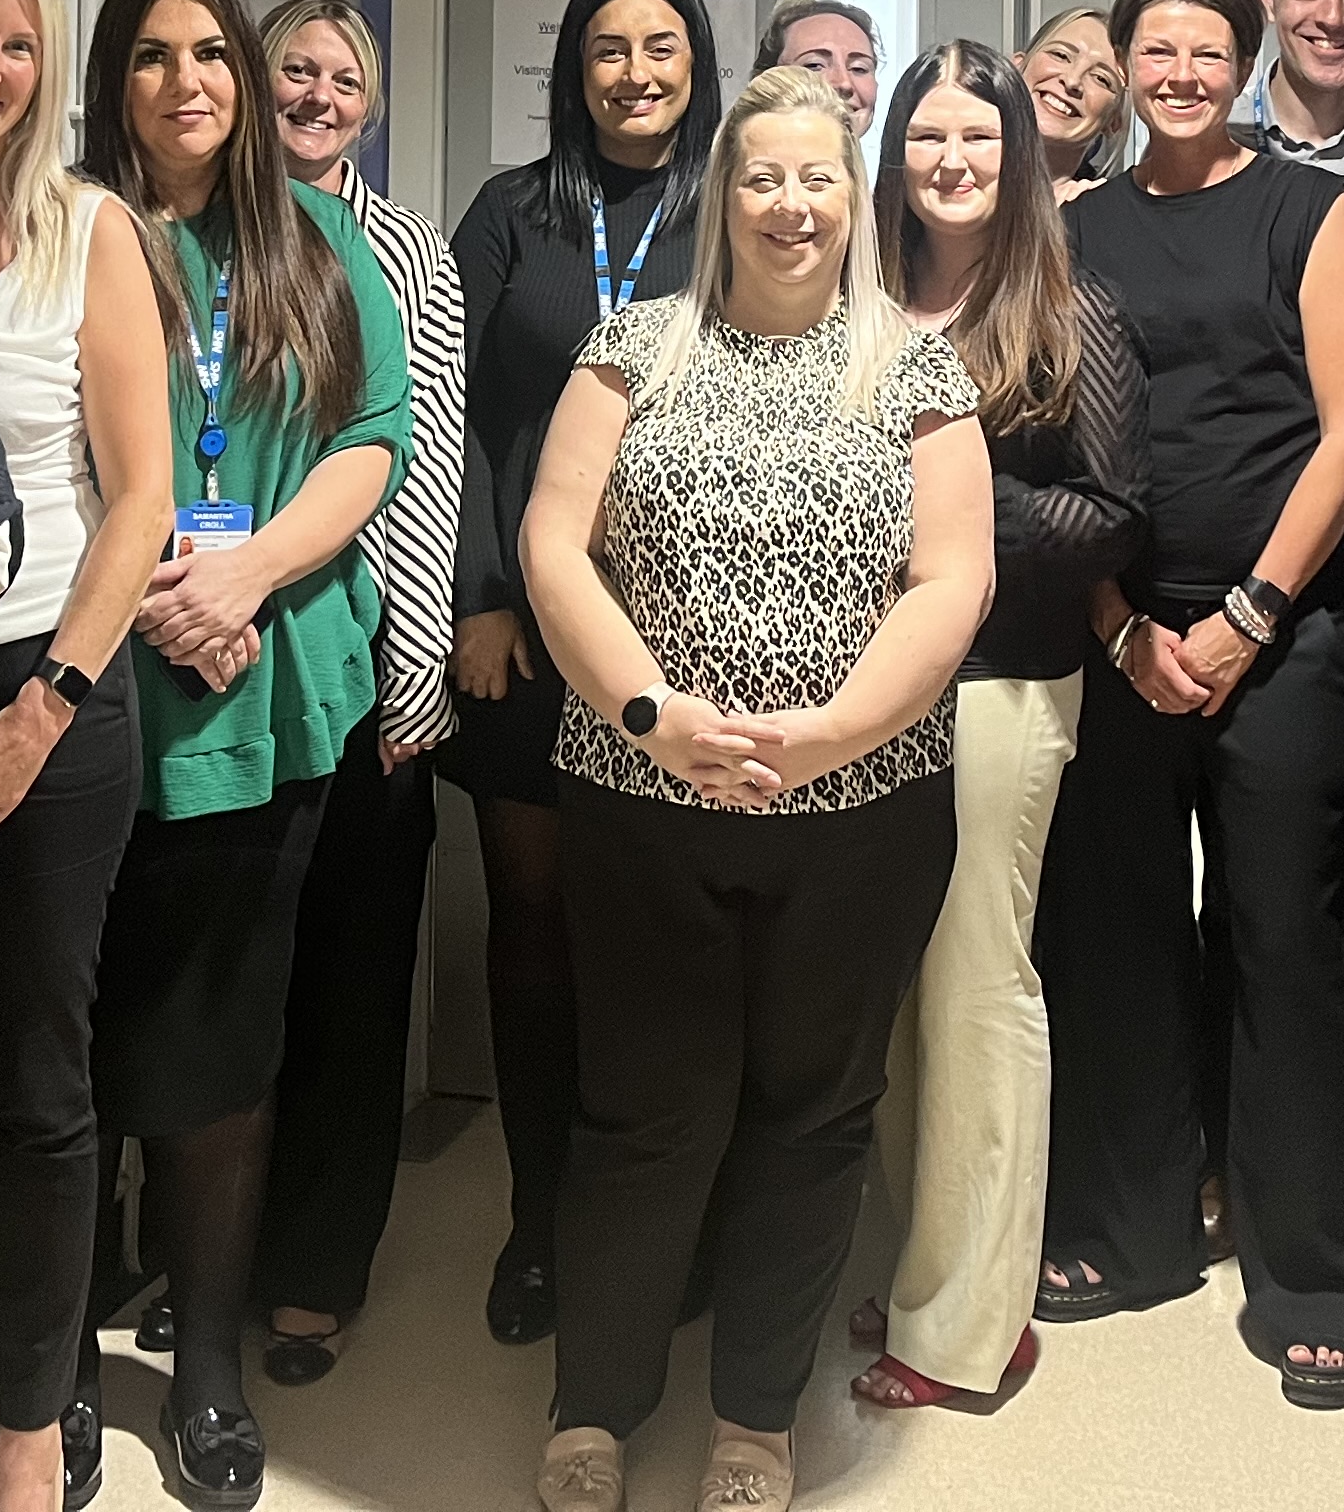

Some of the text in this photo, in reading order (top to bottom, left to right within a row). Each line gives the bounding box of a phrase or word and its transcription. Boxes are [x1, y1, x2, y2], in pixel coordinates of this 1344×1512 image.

[514, 64, 553, 79] Visiting
[719, 67, 734, 78] 00
[537, 79, 552, 93] (M
